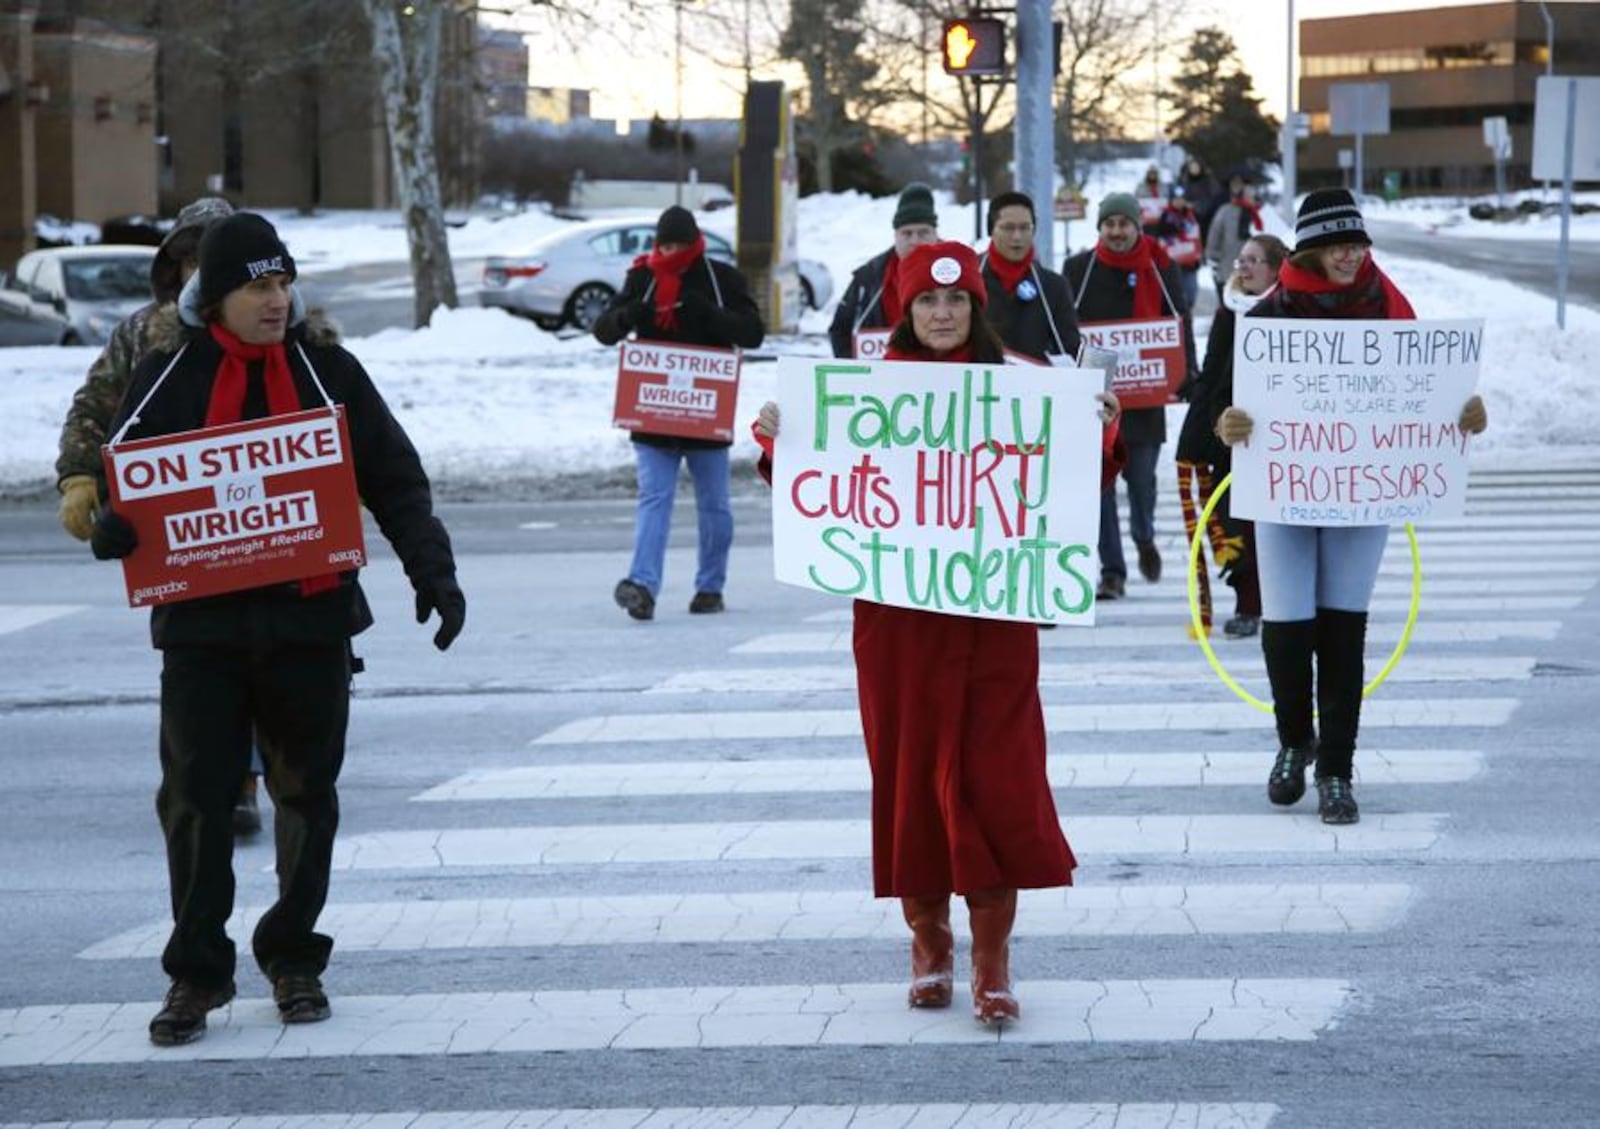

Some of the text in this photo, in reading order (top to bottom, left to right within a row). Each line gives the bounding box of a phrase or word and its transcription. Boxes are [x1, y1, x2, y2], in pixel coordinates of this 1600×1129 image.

[1110, 326, 1176, 346] STRIKE
[1243, 327, 1484, 366] CHERYL B TRIPPIN
[628, 350, 735, 375] ON STRIKE
[643, 387, 712, 406] WRIGHT
[1267, 373, 1436, 393] IF SHE THINKS SHE
[1302, 399, 1426, 413] CAN SCARE ME
[814, 364, 1052, 509] Faculty
[1268, 420, 1470, 456] STAND WITH MY
[123, 428, 336, 489] ON STRIKE
[226, 482, 257, 502] for
[791, 439, 1045, 538] cuts HURT
[1268, 462, 1448, 503] PROFESSORS
[170, 496, 311, 544] WRIGHT
[164, 527, 325, 567] #fighting4wright #Red4Ed
[809, 506, 1094, 620] Students
